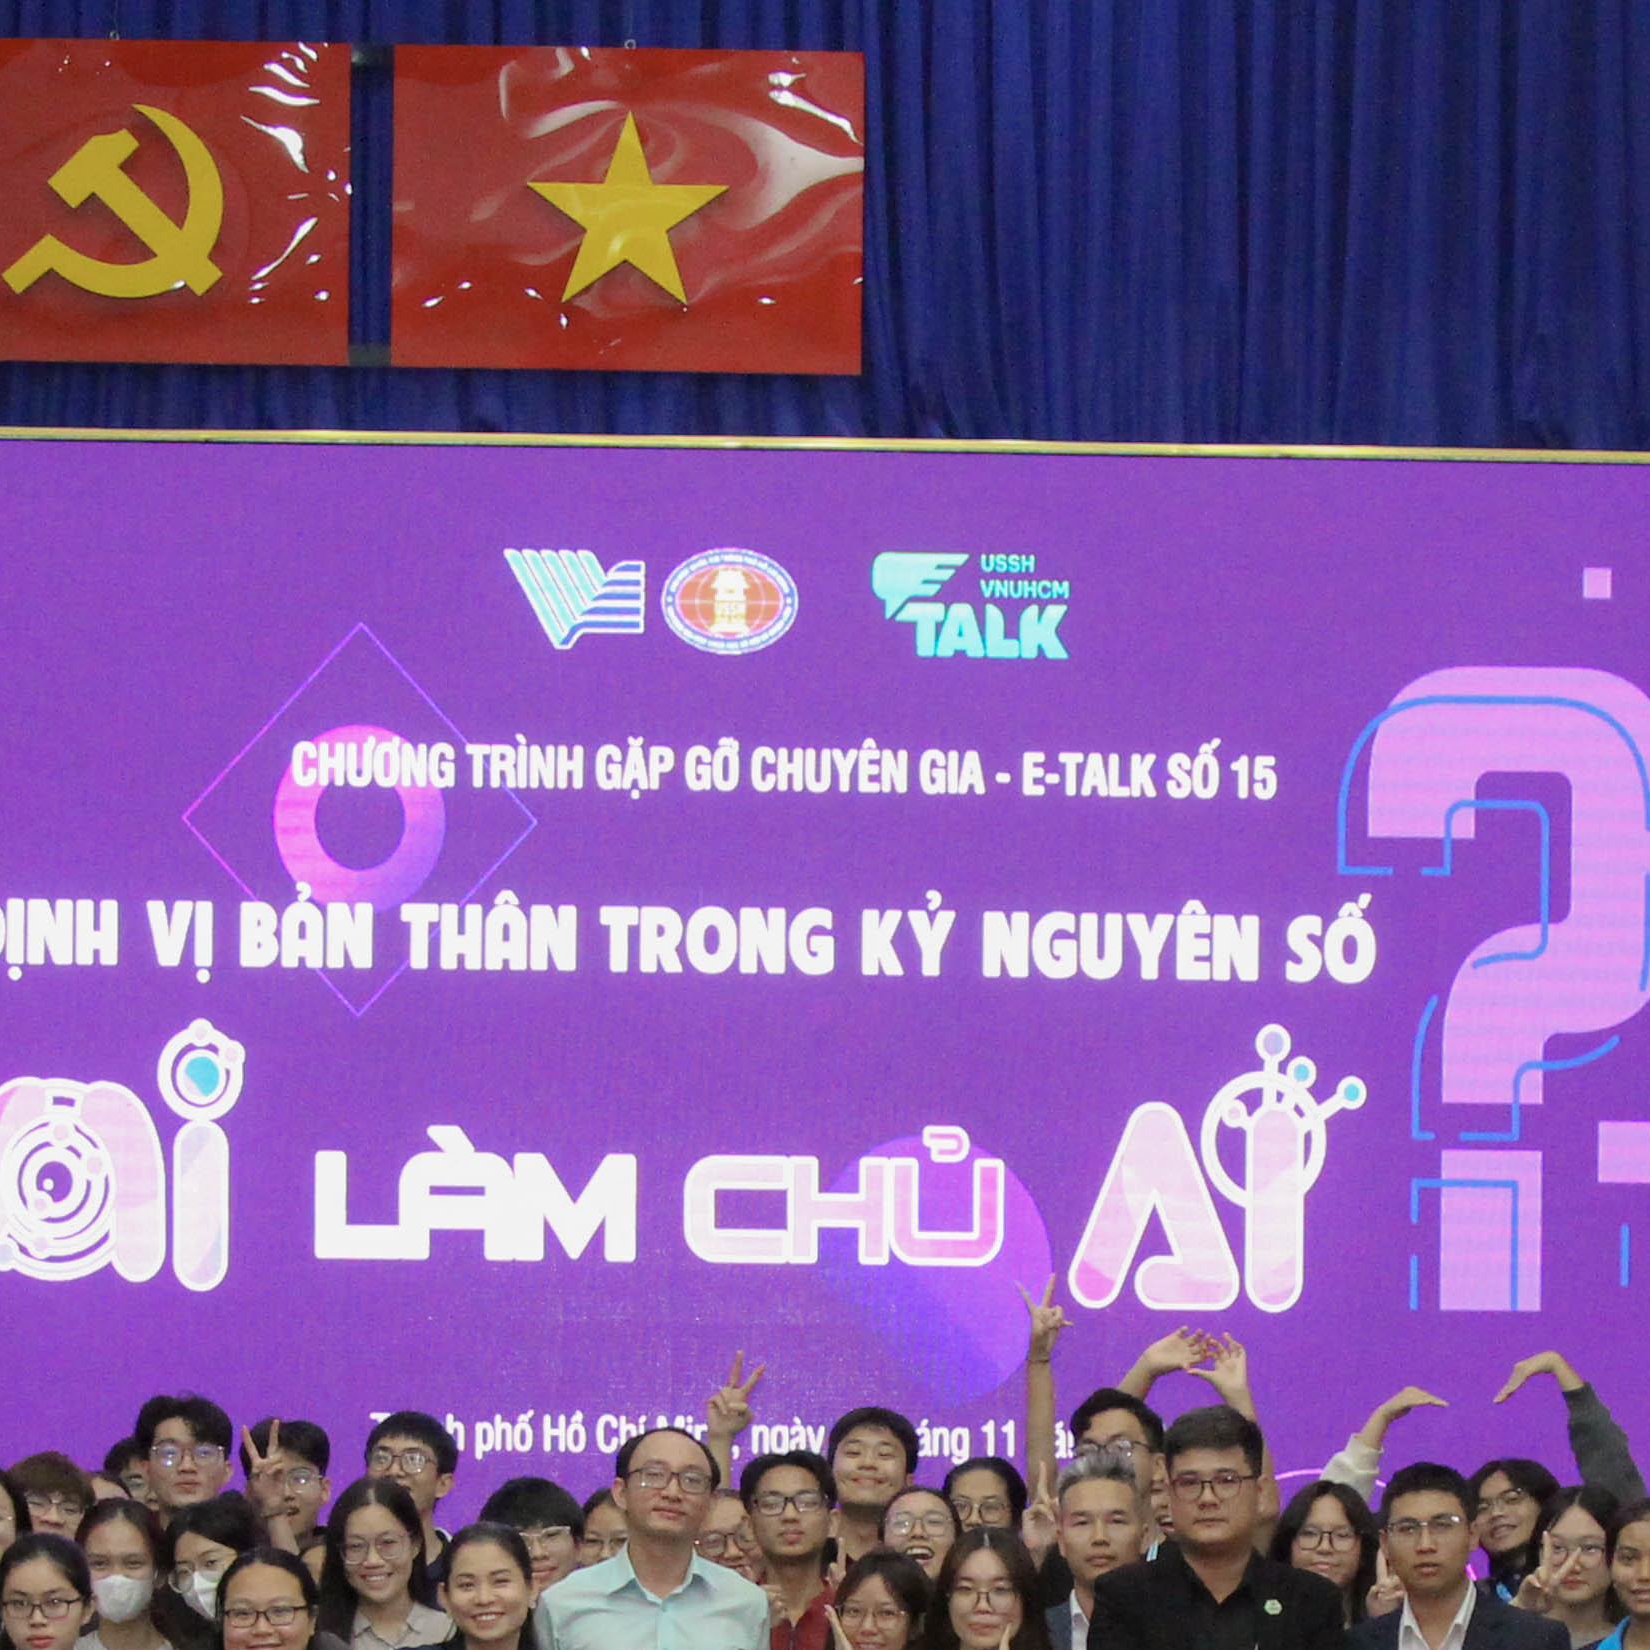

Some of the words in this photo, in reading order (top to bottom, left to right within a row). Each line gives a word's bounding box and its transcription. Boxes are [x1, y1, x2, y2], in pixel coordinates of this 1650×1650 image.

[980, 553, 1036, 573] USSH
[980, 579, 1070, 599] VNUHCM
[895, 602, 1070, 659] TALK
[292, 736, 455, 788] CHƯƠNG
[466, 733, 585, 790] TRÌNH
[595, 736, 675, 800] GẶP
[684, 736, 740, 792] GỠ
[751, 738, 908, 794] CHUYÊN
[919, 748, 986, 796] GIA
[1022, 752, 1157, 799] E-TALK
[1166, 737, 1222, 801] SỐ
[1230, 754, 1277, 801] 15
[147, 899, 214, 984] VỊ
[239, 880, 374, 970] BẢN
[400, 890, 577, 973] THÂN
[599, 904, 835, 976] TRONG
[861, 889, 957, 977] KỶ
[982, 899, 1261, 982] NGUYÊN
[1284, 892, 1377, 985] SỐ
[314, 1125, 637, 1262] LÀM
[683, 1125, 1004, 1267] CHỦ
[474, 1409, 535, 1460] phố
[543, 1410, 587, 1454] Hồ
[916, 1418, 971, 1465] áng
[981, 1419, 1016, 1458] 11
